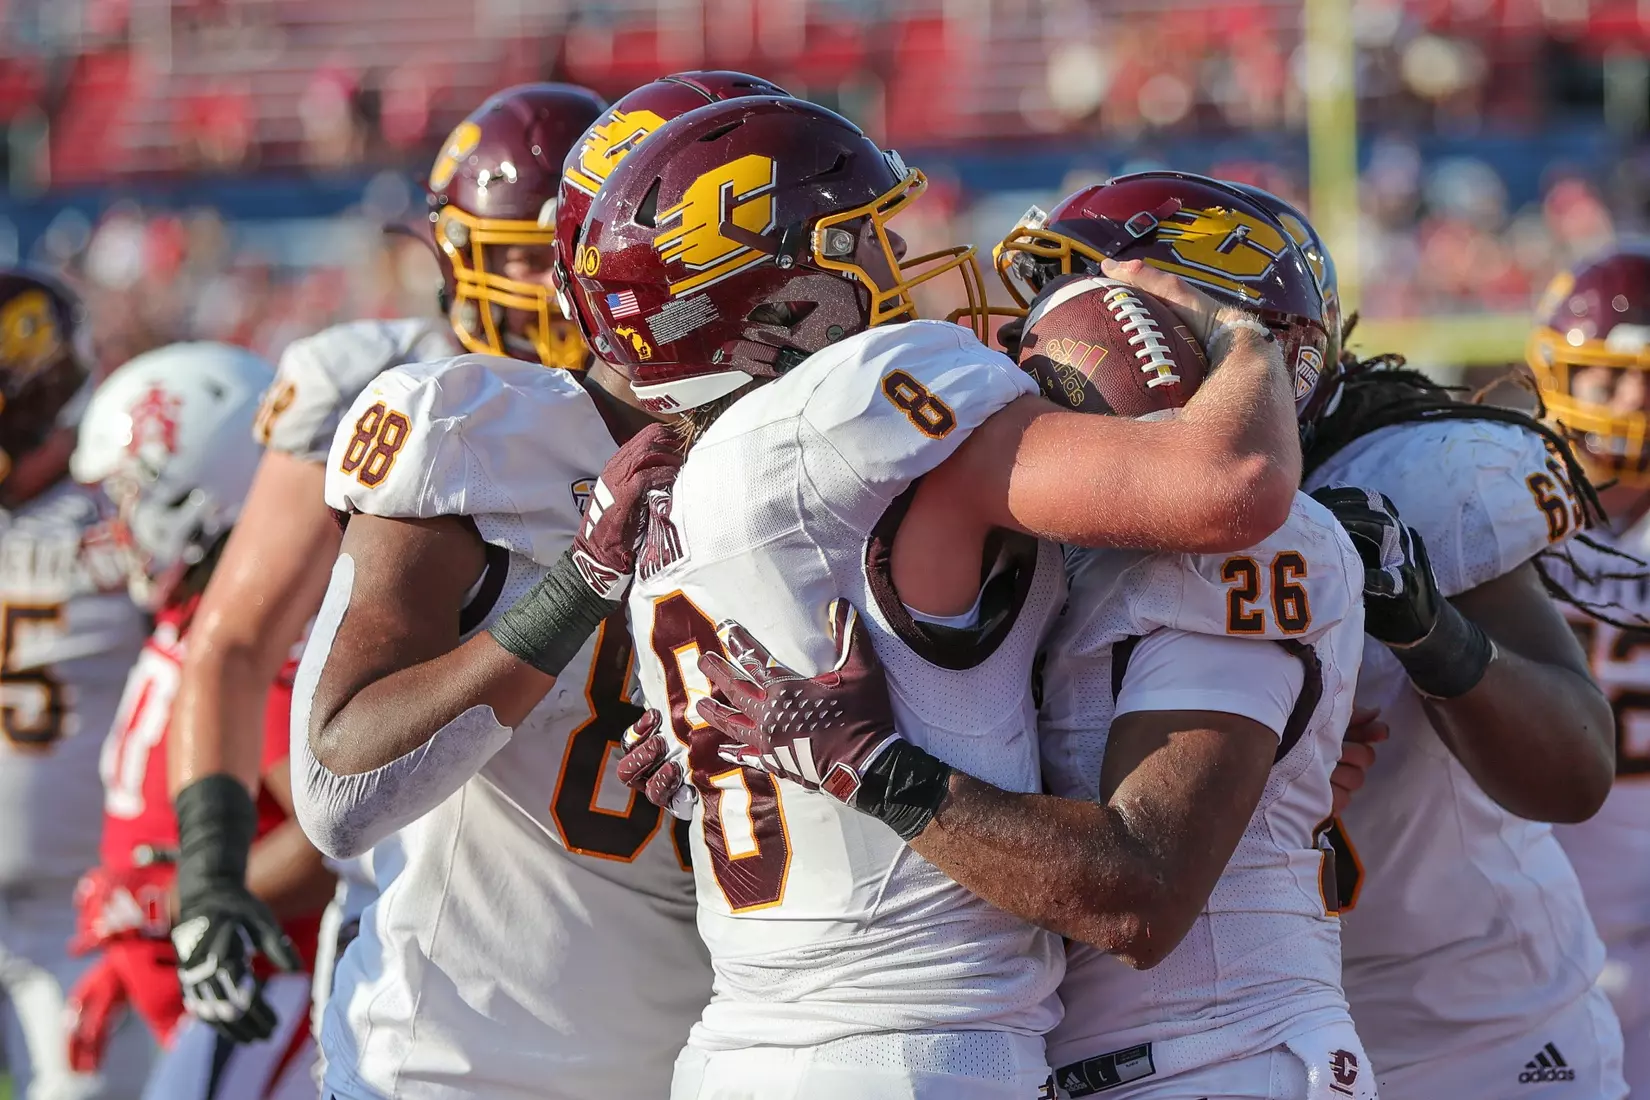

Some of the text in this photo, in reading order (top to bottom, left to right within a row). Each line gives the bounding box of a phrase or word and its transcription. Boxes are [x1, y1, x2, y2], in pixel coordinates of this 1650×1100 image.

[880, 368, 958, 440] 8
[1046, 339, 1085, 407] adidas
[340, 400, 413, 489] 88
[1221, 550, 1312, 634] 26
[650, 589, 792, 913] 8
[1518, 1067, 1576, 1084] adidas
